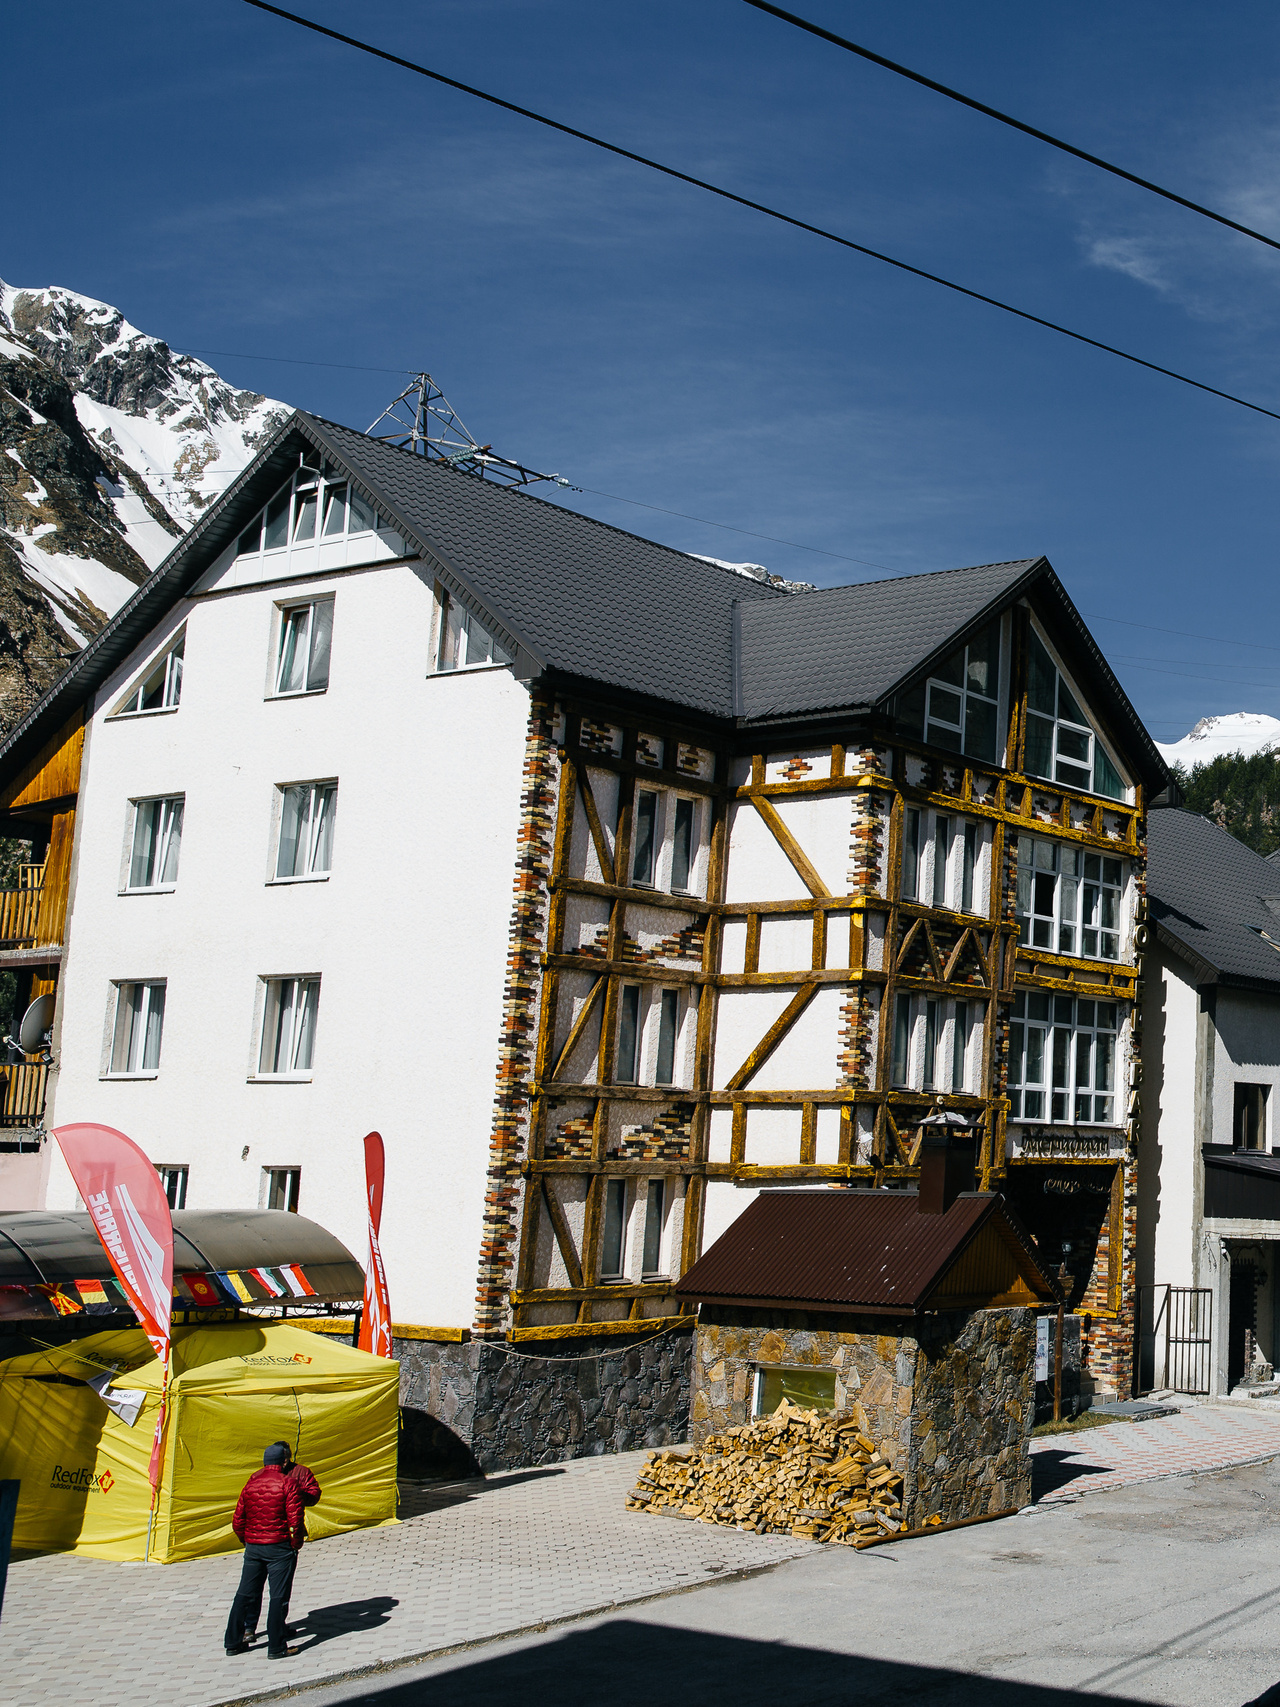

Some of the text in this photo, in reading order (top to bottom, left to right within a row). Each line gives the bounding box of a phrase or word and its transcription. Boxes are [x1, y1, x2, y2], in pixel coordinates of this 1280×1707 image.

[1127, 897, 1149, 1142] HOTEL BAR
[52, 1465, 101, 1486] RedFox
[50, 1482, 101, 1494] outdoor equipment
